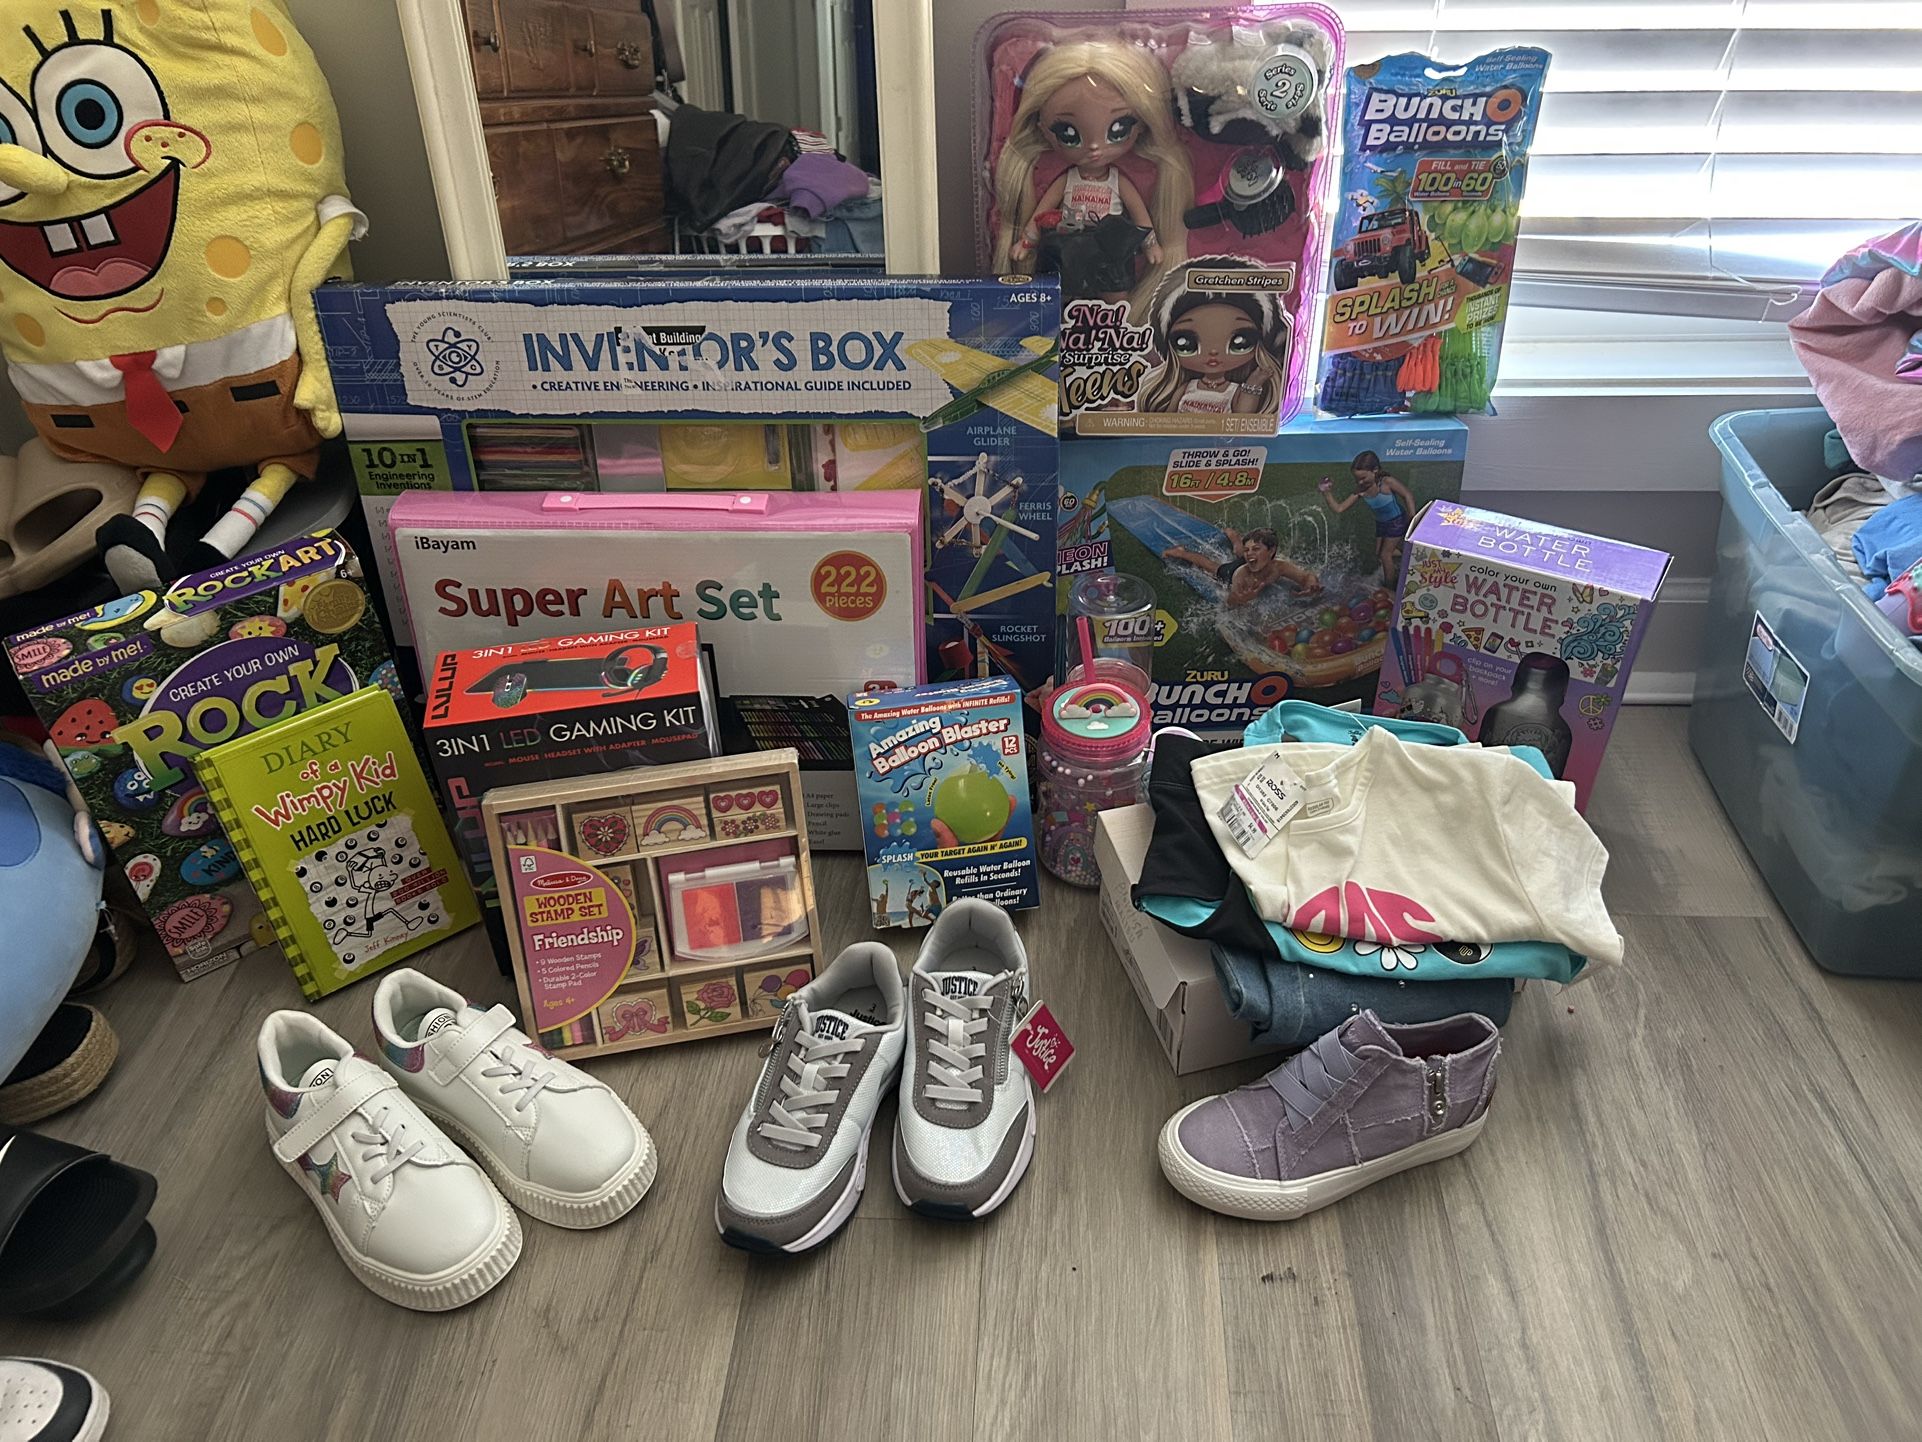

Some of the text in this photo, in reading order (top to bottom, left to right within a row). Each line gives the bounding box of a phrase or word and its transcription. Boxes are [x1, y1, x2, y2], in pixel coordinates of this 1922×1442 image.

[1265, 63, 1296, 80] Series
[1475, 61, 1544, 71] Water Balloons
[1270, 79, 1291, 98] 2
[1258, 89, 1278, 111] Serie
[1364, 89, 1522, 122] BUNCH O
[1366, 123, 1505, 146] Balloons
[1431, 161, 1486, 170] FILL and TIE
[1418, 172, 1493, 191] 100 in 60
[1195, 275, 1283, 288] Gretchen Stripes
[1010, 293, 1052, 303] AGES 8+
[1334, 276, 1438, 323] SPLASH
[1466, 293, 1501, 312] INSTANT
[416, 311, 476, 330] YOUNG SCIENTISTS
[1071, 305, 1124, 326] Na!
[1348, 297, 1454, 340] TO WIN!
[1467, 304, 1498, 323] PRIZES
[1099, 328, 1151, 350] Na!
[809, 331, 907, 372] BOX
[1063, 351, 1130, 366] Surprise
[541, 381, 911, 392] CREATIVE GUIDE INCLUDED
[966, 426, 1016, 435] AIRPLANE
[973, 437, 1010, 446] GLIDER
[1394, 439, 1446, 448] Self-Sealing
[361, 447, 397, 468] 10
[1182, 450, 1220, 459] THROW
[1233, 449, 1251, 457] GO!
[1386, 447, 1452, 456] Water Balloons
[1172, 457, 1259, 469] SLIDE & SPLASH!
[369, 471, 435, 482] Engineering
[376, 481, 433, 490] Inventions
[1019, 512, 1052, 521] WHEEL
[1020, 503, 1052, 511] FERRIS
[415, 536, 476, 553] iBayam
[1494, 526, 1591, 558] WATER
[209, 549, 286, 578] CREATE YOUR OWN
[1477, 535, 1593, 573] BOTTLE
[1422, 560, 1441, 568] JUST
[163, 559, 283, 613] ROCK
[280, 538, 337, 572] ART
[820, 565, 877, 593] 222
[1419, 572, 1458, 588] Style
[1469, 564, 1557, 592] color your own
[434, 578, 783, 627] Super Art Set
[1465, 574, 1557, 616] WATER
[1450, 593, 1559, 639] BOTTLE
[16, 624, 54, 642] made
[67, 612, 90, 625] me!
[1000, 625, 1038, 633] ROCKET
[472, 646, 512, 659] 3IN1
[557, 631, 640, 647] GAMING
[644, 627, 671, 636] KIT
[992, 634, 1046, 642] SLINGSHOT
[16, 645, 48, 662] SMILE
[41, 640, 144, 688] made by me!
[168, 644, 301, 703] CREATE YOUR OWN
[1186, 670, 1229, 681] ZURU
[873, 710, 900, 719] Amazing
[901, 708, 920, 716] Water
[920, 705, 947, 714] Balloons
[948, 703, 961, 711] with
[962, 699, 988, 708] INFINITE
[989, 696, 1010, 705] Refills!
[111, 643, 344, 793] ROCK
[436, 707, 697, 757] 3IN1 LED GAMING KIT
[869, 716, 942, 759] Amazing
[260, 722, 352, 775] DIARY
[508, 754, 540, 764] MOUSE
[544, 749, 581, 759] HEADSET
[583, 745, 606, 755] WITH
[609, 740, 646, 750] ADAPTER
[651, 733, 698, 744] MOUSEPAD
[873, 718, 1011, 775] Balloon Blaster
[1004, 736, 1017, 748] 12
[299, 761, 342, 781] of a
[252, 752, 398, 830] Wimpy Kid
[1266, 778, 1286, 800] ROSS
[289, 791, 397, 852] HARD LUCK
[882, 839, 1023, 864] SPLASH YOUR TARGET AGAIN AGAIN!
[944, 859, 1031, 878] Reusable Water Balloon
[955, 869, 1021, 884] Refills Seconds!
[535, 891, 593, 909] WOODEN
[977, 887, 1028, 900] than Ordinary
[168, 908, 205, 938] SMILE
[529, 904, 603, 923] STAMP SET
[365, 942, 380, 953] Jeff
[532, 925, 624, 951] Friendship
[547, 953, 601, 964] Wooden Stamps
[543, 971, 597, 983] Durable 2-Color
[548, 965, 575, 973] Colored
[544, 982, 567, 990] Stamp
[941, 976, 978, 996] JUSTICE
